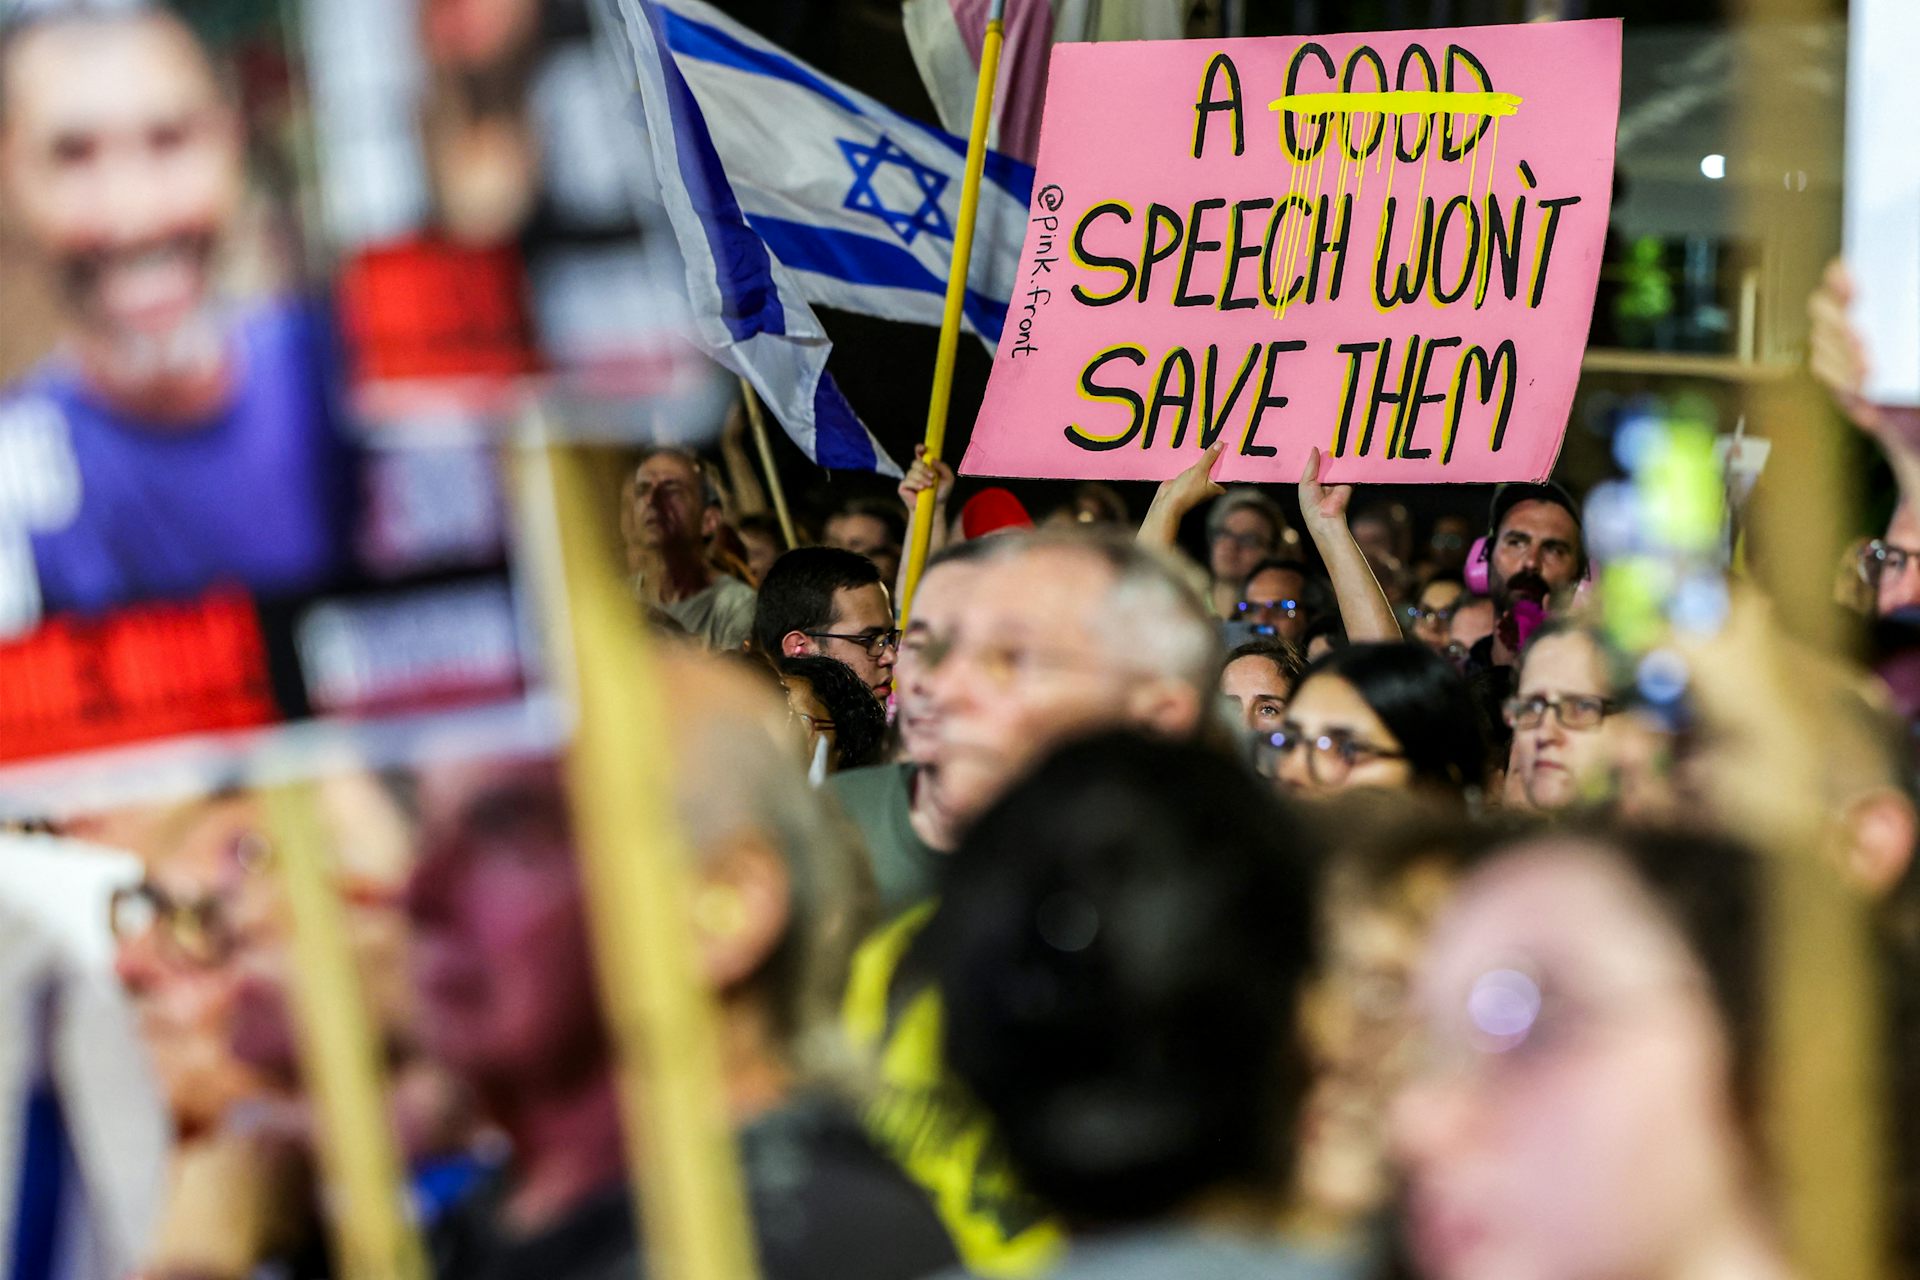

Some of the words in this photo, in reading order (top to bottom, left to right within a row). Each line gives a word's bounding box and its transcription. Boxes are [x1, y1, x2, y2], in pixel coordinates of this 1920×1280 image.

[1192, 52, 1244, 158] A
[1281, 43, 1496, 162] GOOD
[1011, 184, 1064, 359] @pink.front
[1070, 192, 1352, 311] SPEECH
[1372, 161, 1581, 311] WON'T
[1064, 340, 1308, 457] SAVE
[1331, 335, 1518, 465] THEM
